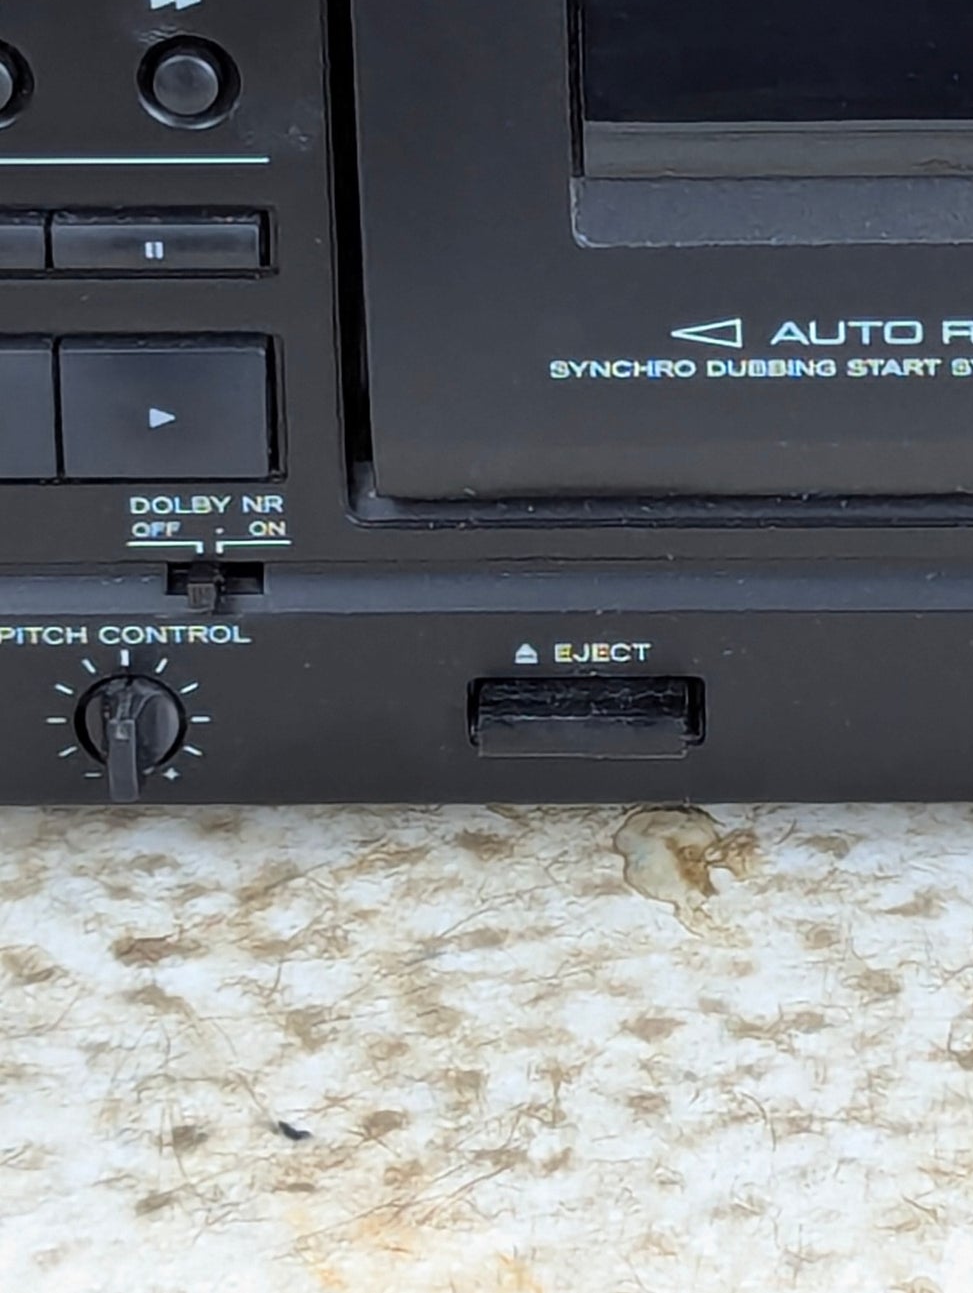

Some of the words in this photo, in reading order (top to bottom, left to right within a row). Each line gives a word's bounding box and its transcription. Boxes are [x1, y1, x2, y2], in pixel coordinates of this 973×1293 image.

[770, 321, 924, 346] AUTO
[550, 359, 695, 379] SYNCHRO
[707, 359, 837, 378] DUBBING
[847, 359, 941, 377] START
[130, 496, 231, 514] DOLBY
[242, 495, 283, 513] NR
[132, 521, 182, 537] OFF
[248, 521, 286, 537] ON
[0, 626, 88, 644] PITCH
[98, 626, 252, 644] CONTROL
[554, 643, 652, 663] EJECT
